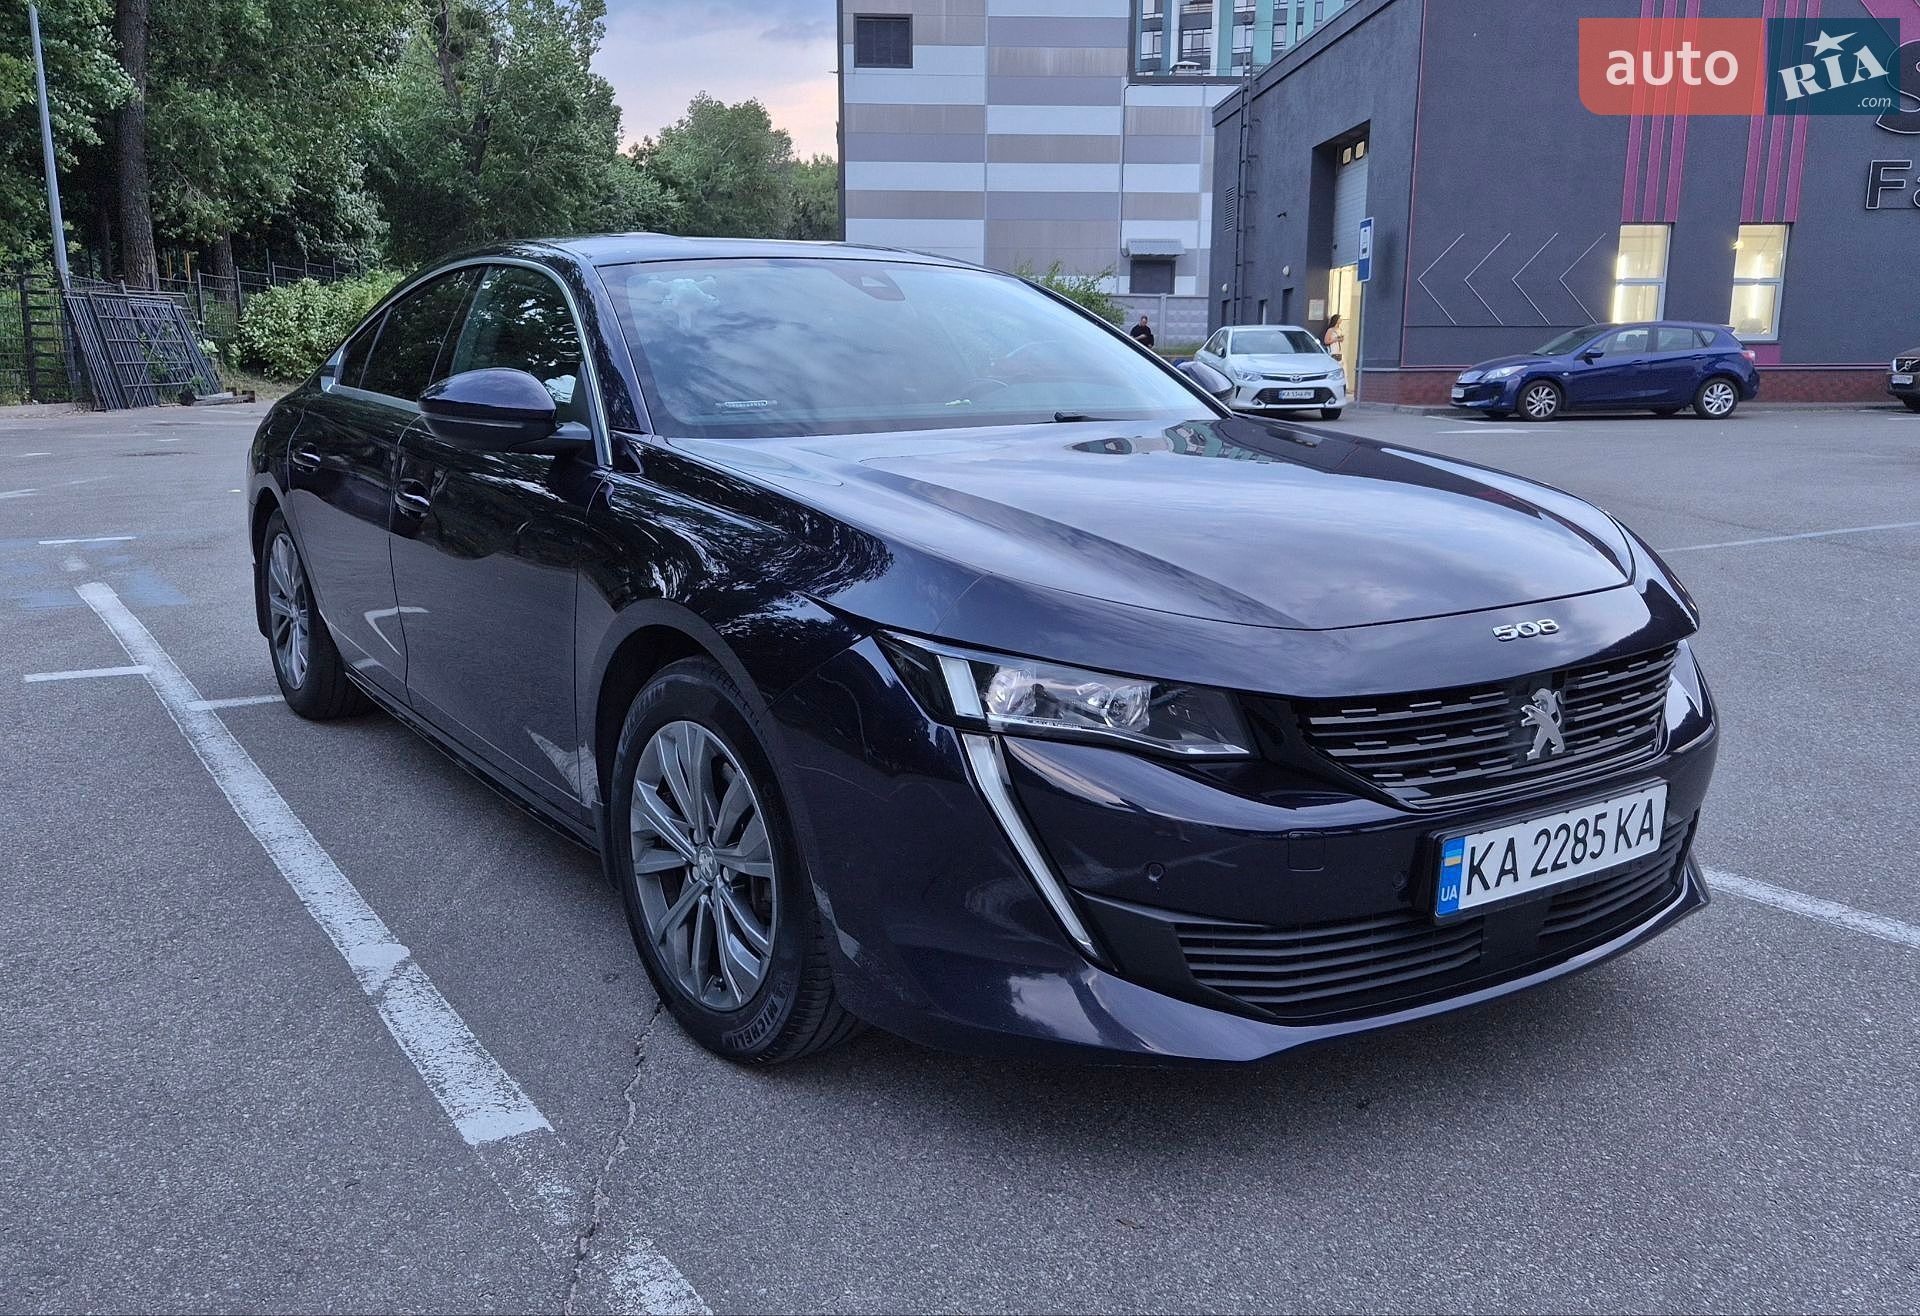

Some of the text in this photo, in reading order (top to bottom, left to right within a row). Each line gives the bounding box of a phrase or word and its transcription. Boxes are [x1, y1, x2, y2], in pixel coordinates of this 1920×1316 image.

[1866, 160, 1920, 209] F
[1493, 619, 1559, 641] 508
[1466, 799, 1654, 895] KA 2285 KA
[1441, 886, 1458, 901] UA
